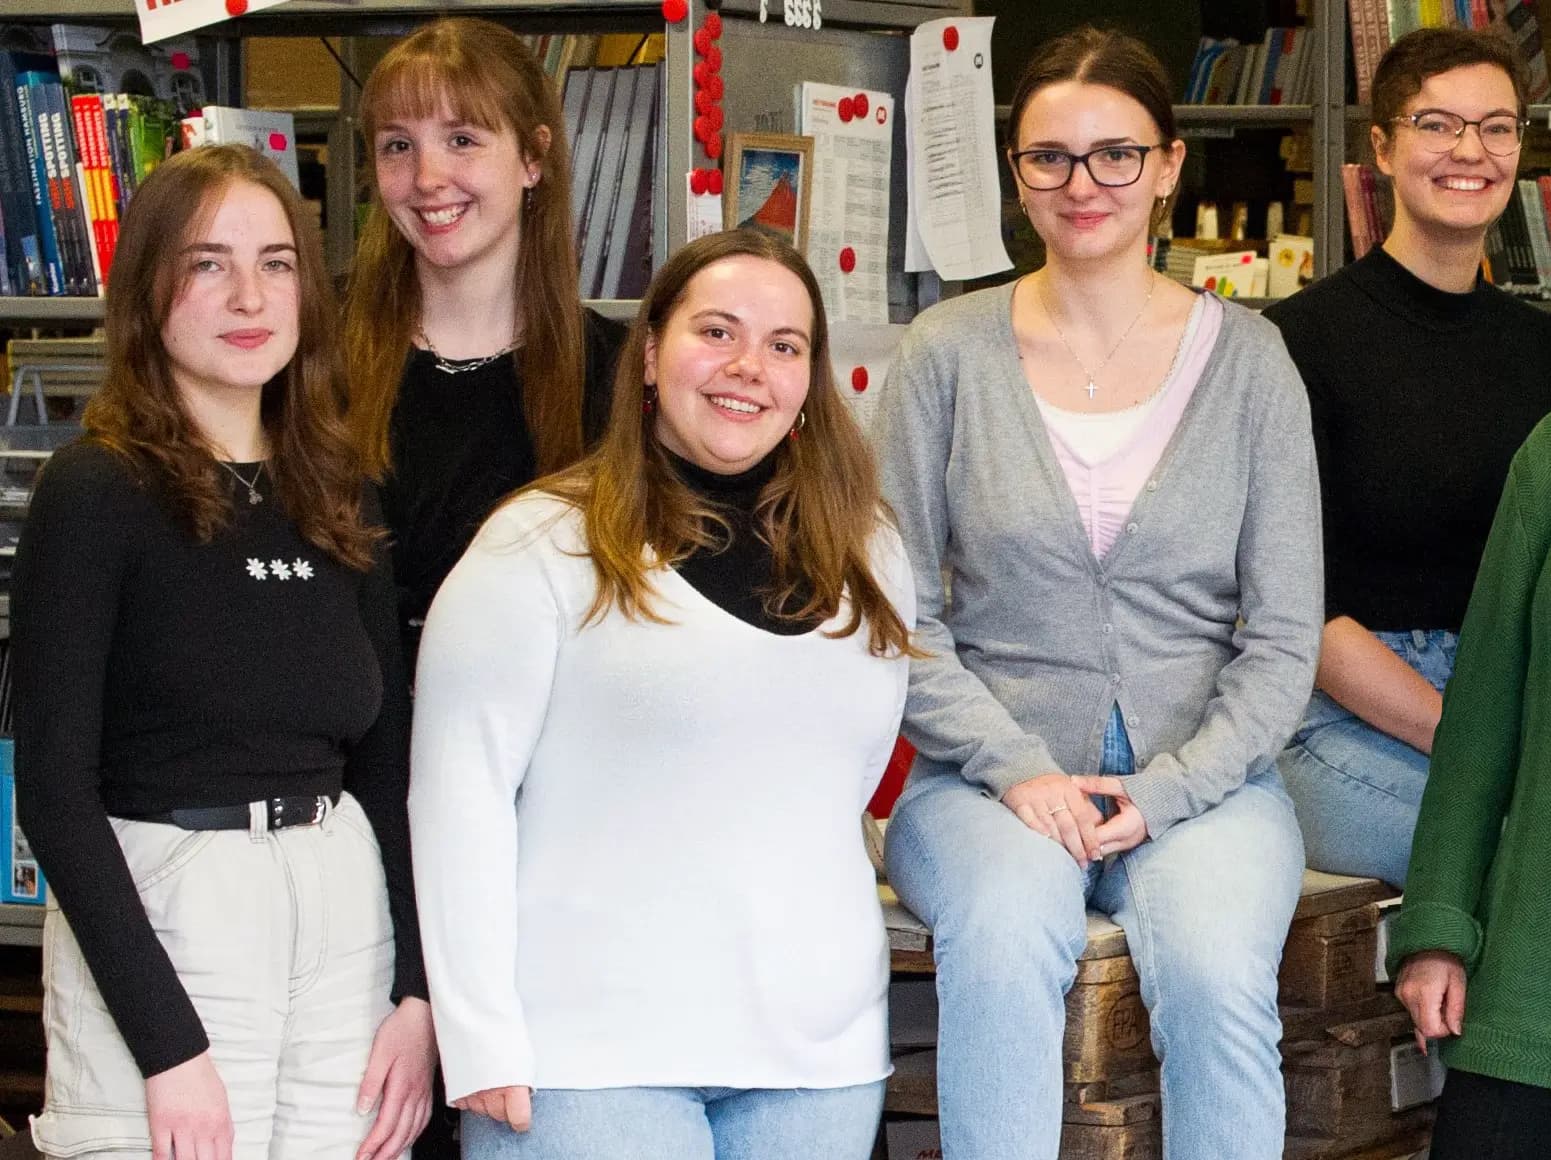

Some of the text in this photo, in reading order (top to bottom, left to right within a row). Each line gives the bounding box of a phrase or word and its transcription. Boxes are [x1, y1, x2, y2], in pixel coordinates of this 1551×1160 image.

[17, 86, 30, 136] HAMBURG
[26, 139, 42, 206] FASZINATION
[38, 112, 57, 178] SPOTTING
[51, 112, 70, 178] SPOTTING
